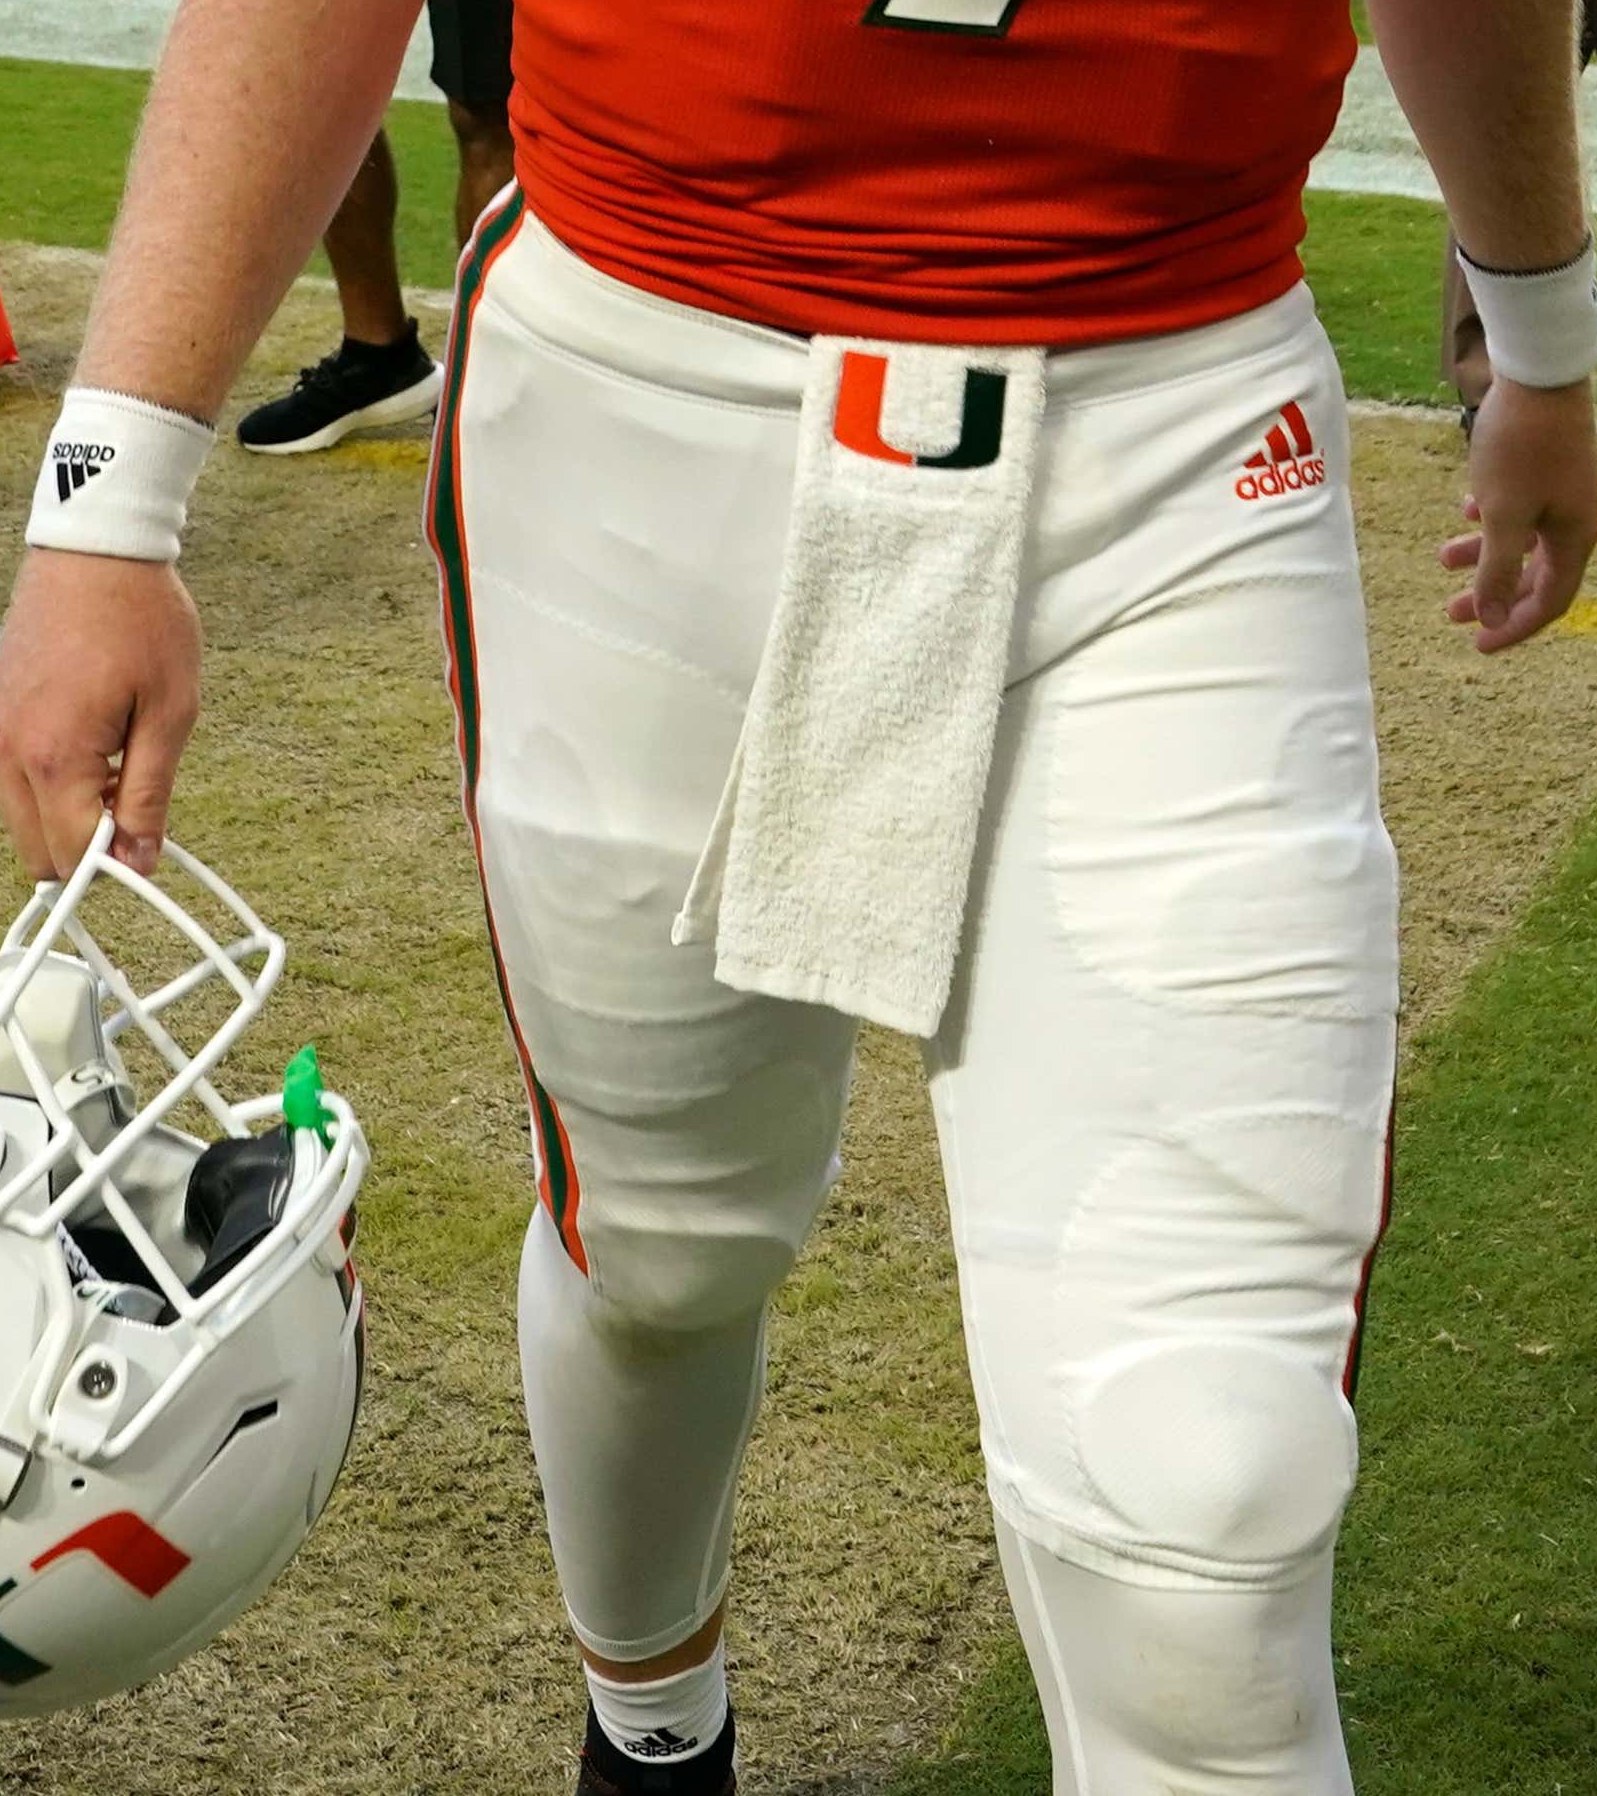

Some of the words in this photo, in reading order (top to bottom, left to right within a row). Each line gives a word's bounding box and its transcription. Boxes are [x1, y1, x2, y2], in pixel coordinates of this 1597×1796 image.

[833, 351, 1006, 469] U
[52, 443, 116, 462] adidas
[1235, 457, 1325, 501] adidas
[624, 1736, 698, 1757] adidas
